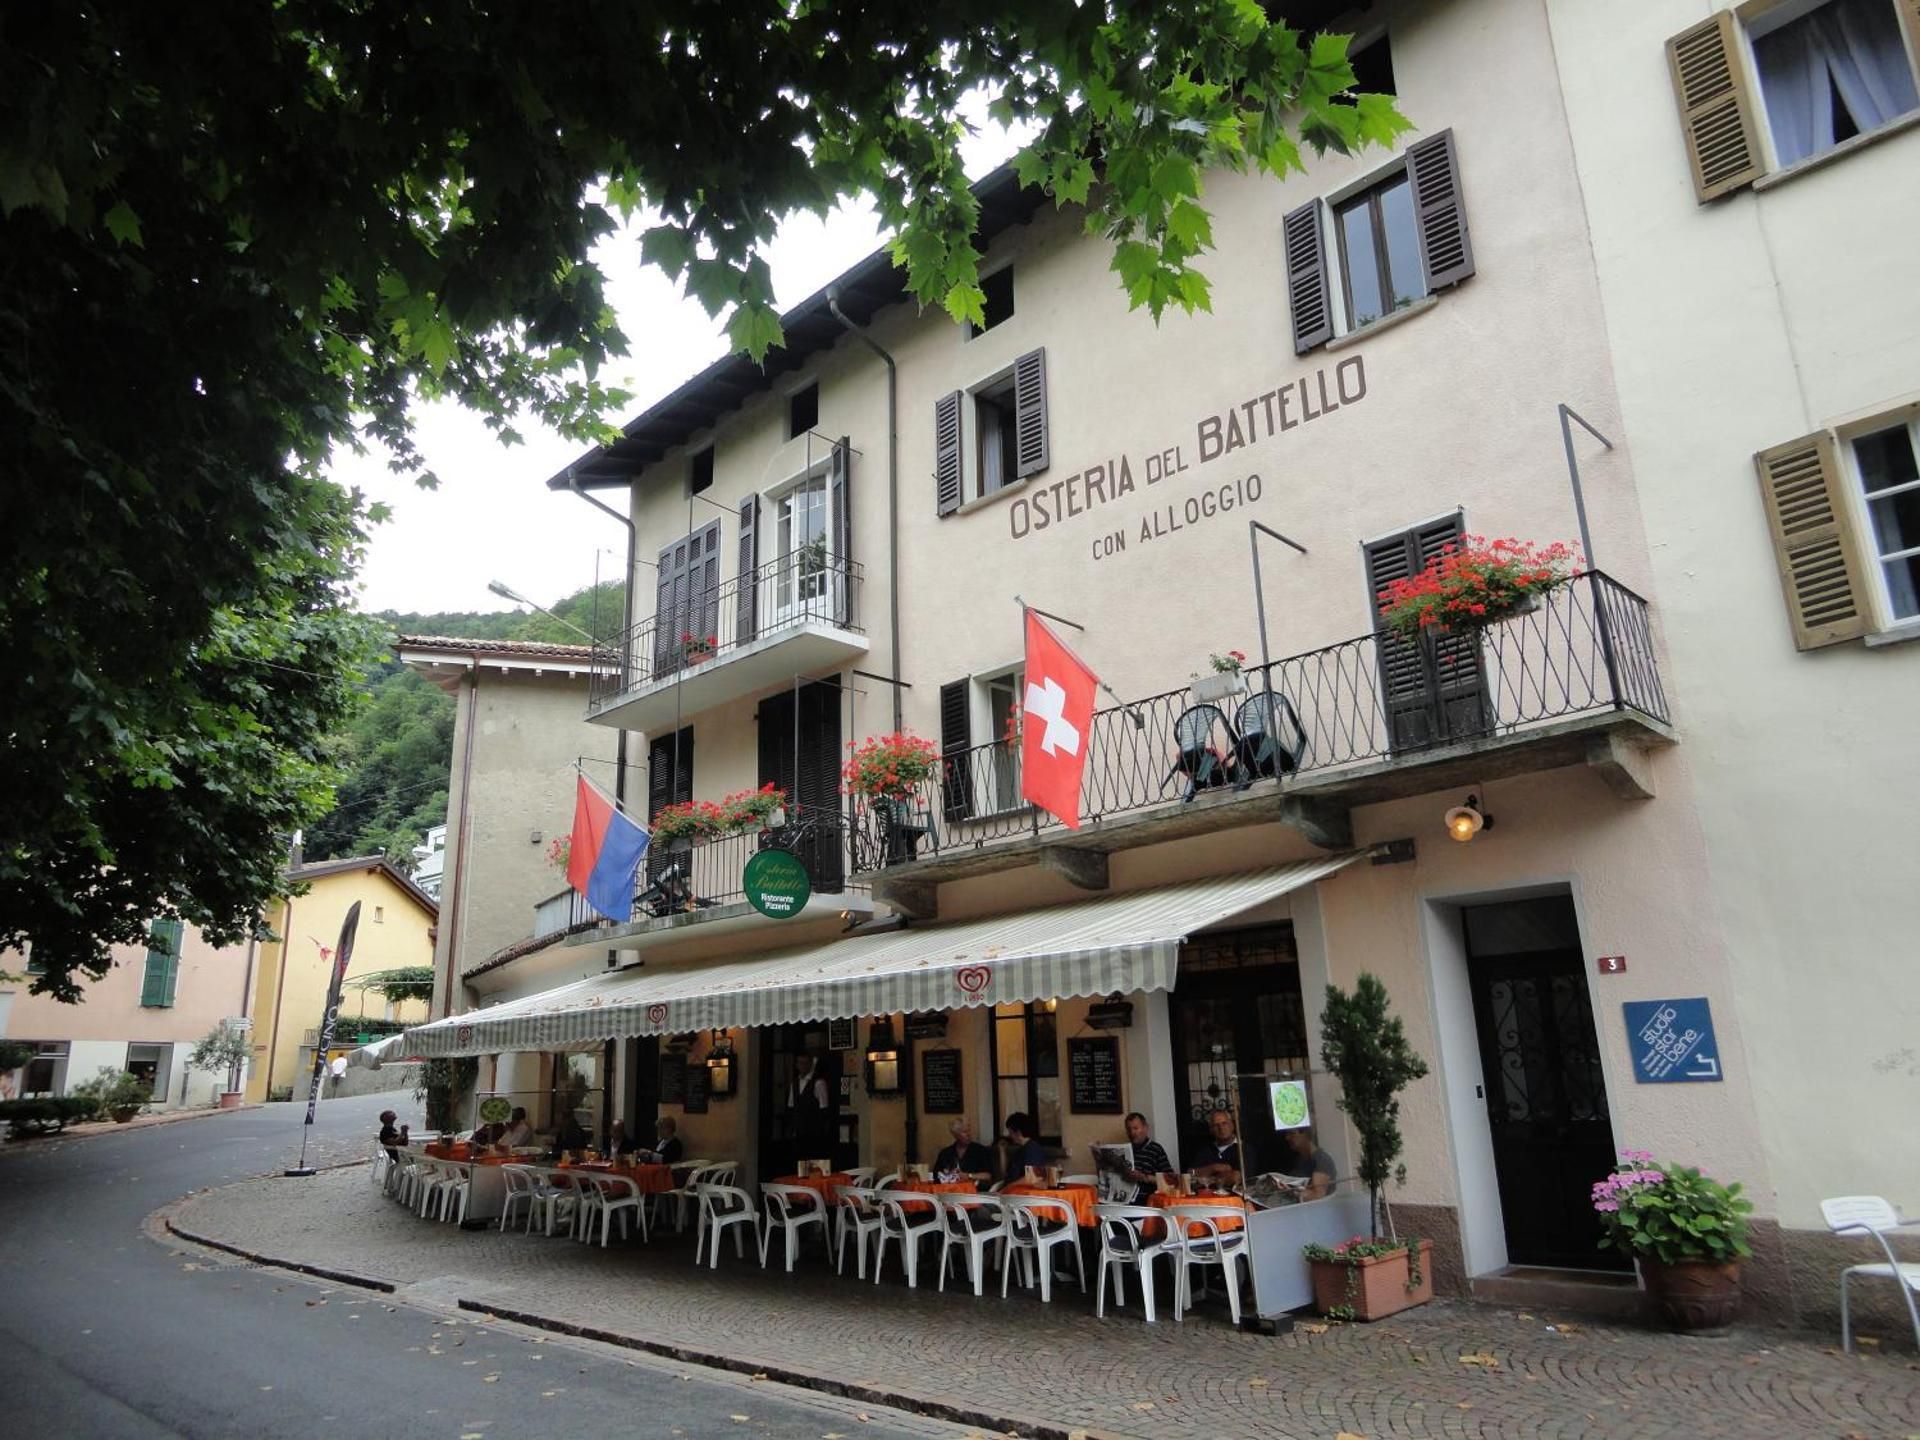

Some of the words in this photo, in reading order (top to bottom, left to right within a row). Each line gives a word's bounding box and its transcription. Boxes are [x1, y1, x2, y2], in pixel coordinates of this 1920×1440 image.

[1009, 454, 1135, 539] OSTERIA
[1146, 445, 1189, 485] DEL
[1197, 354, 1367, 464] BATTELLO
[1092, 529, 1126, 560] CON
[1139, 474, 1262, 543] ALLOGGIO
[761, 893, 795, 904] Ristorante
[764, 902, 791, 911] Pizzeria
[1608, 959, 1617, 970] 3
[1643, 1008, 1677, 1044] studio
[1655, 1028, 1678, 1053] star
[1663, 1028, 1697, 1062] bene
